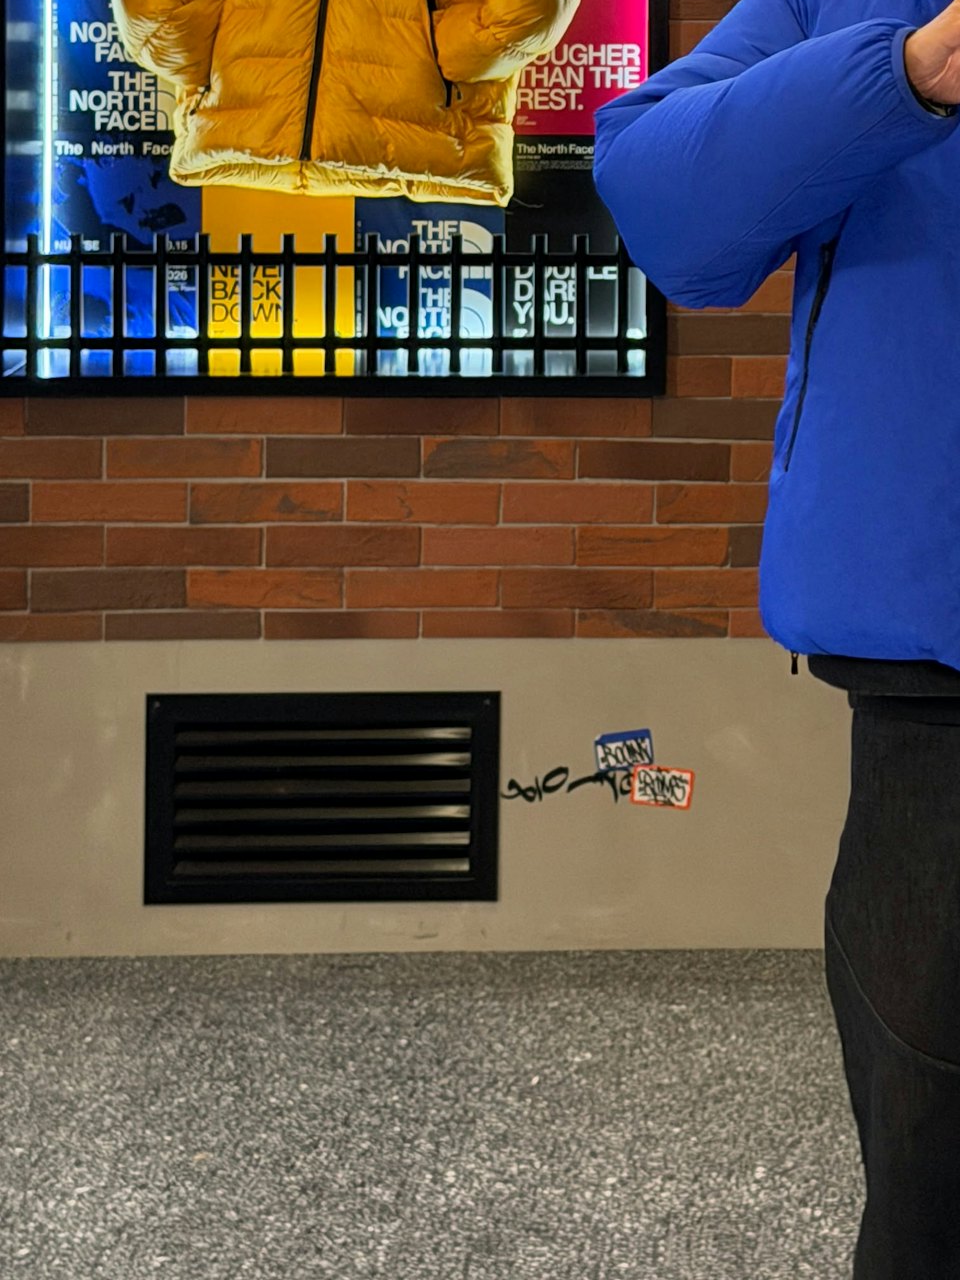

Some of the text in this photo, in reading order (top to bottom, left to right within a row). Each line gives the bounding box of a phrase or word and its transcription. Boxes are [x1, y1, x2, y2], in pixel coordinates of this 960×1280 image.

[533, 43, 641, 66] UGHER
[108, 71, 156, 91] THE
[589, 66, 641, 89] THE
[69, 90, 156, 111] NORTH
[516, 88, 584, 110] REST.
[95, 110, 156, 131] FACE
[54, 140, 84, 155] The
[91, 141, 134, 155] North
[516, 144, 537, 154] The
[537, 144, 568, 154] North
[411, 220, 459, 240] THE
[514, 280, 577, 301] DRE
